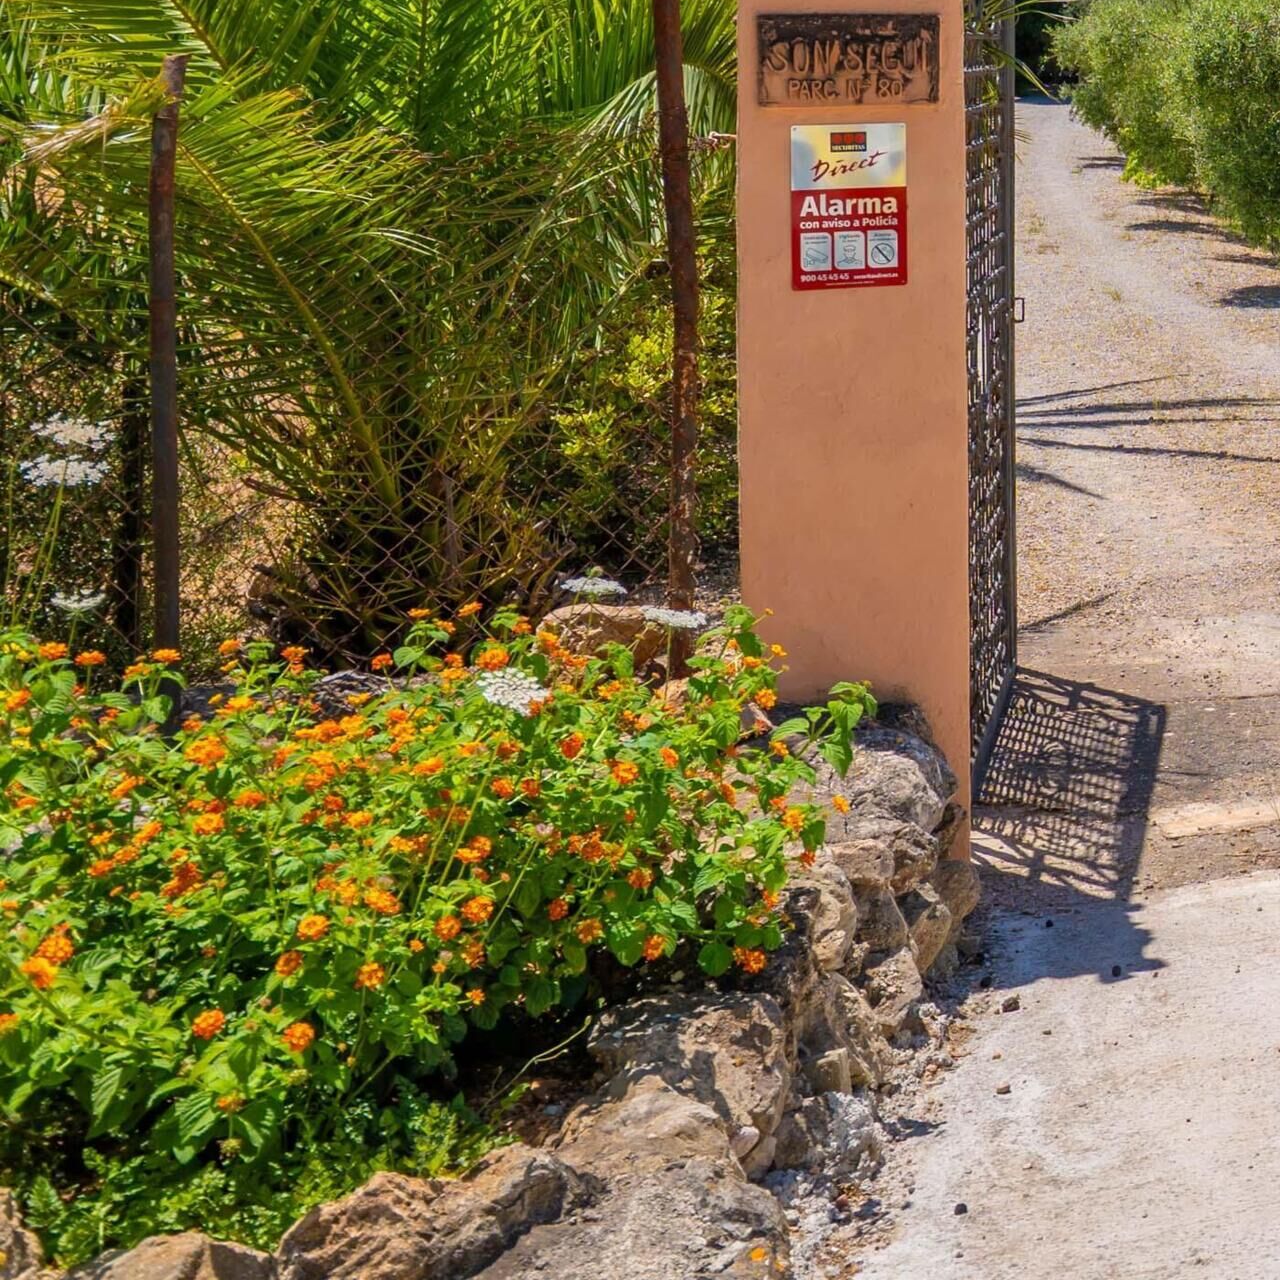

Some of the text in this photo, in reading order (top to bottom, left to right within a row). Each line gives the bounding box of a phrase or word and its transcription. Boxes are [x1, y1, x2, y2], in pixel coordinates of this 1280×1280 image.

[878, 78, 903, 98] 80
[810, 151, 888, 182] Direct
[800, 194, 898, 217] Alarma
[800, 216, 898, 229] con aviso a Policía
